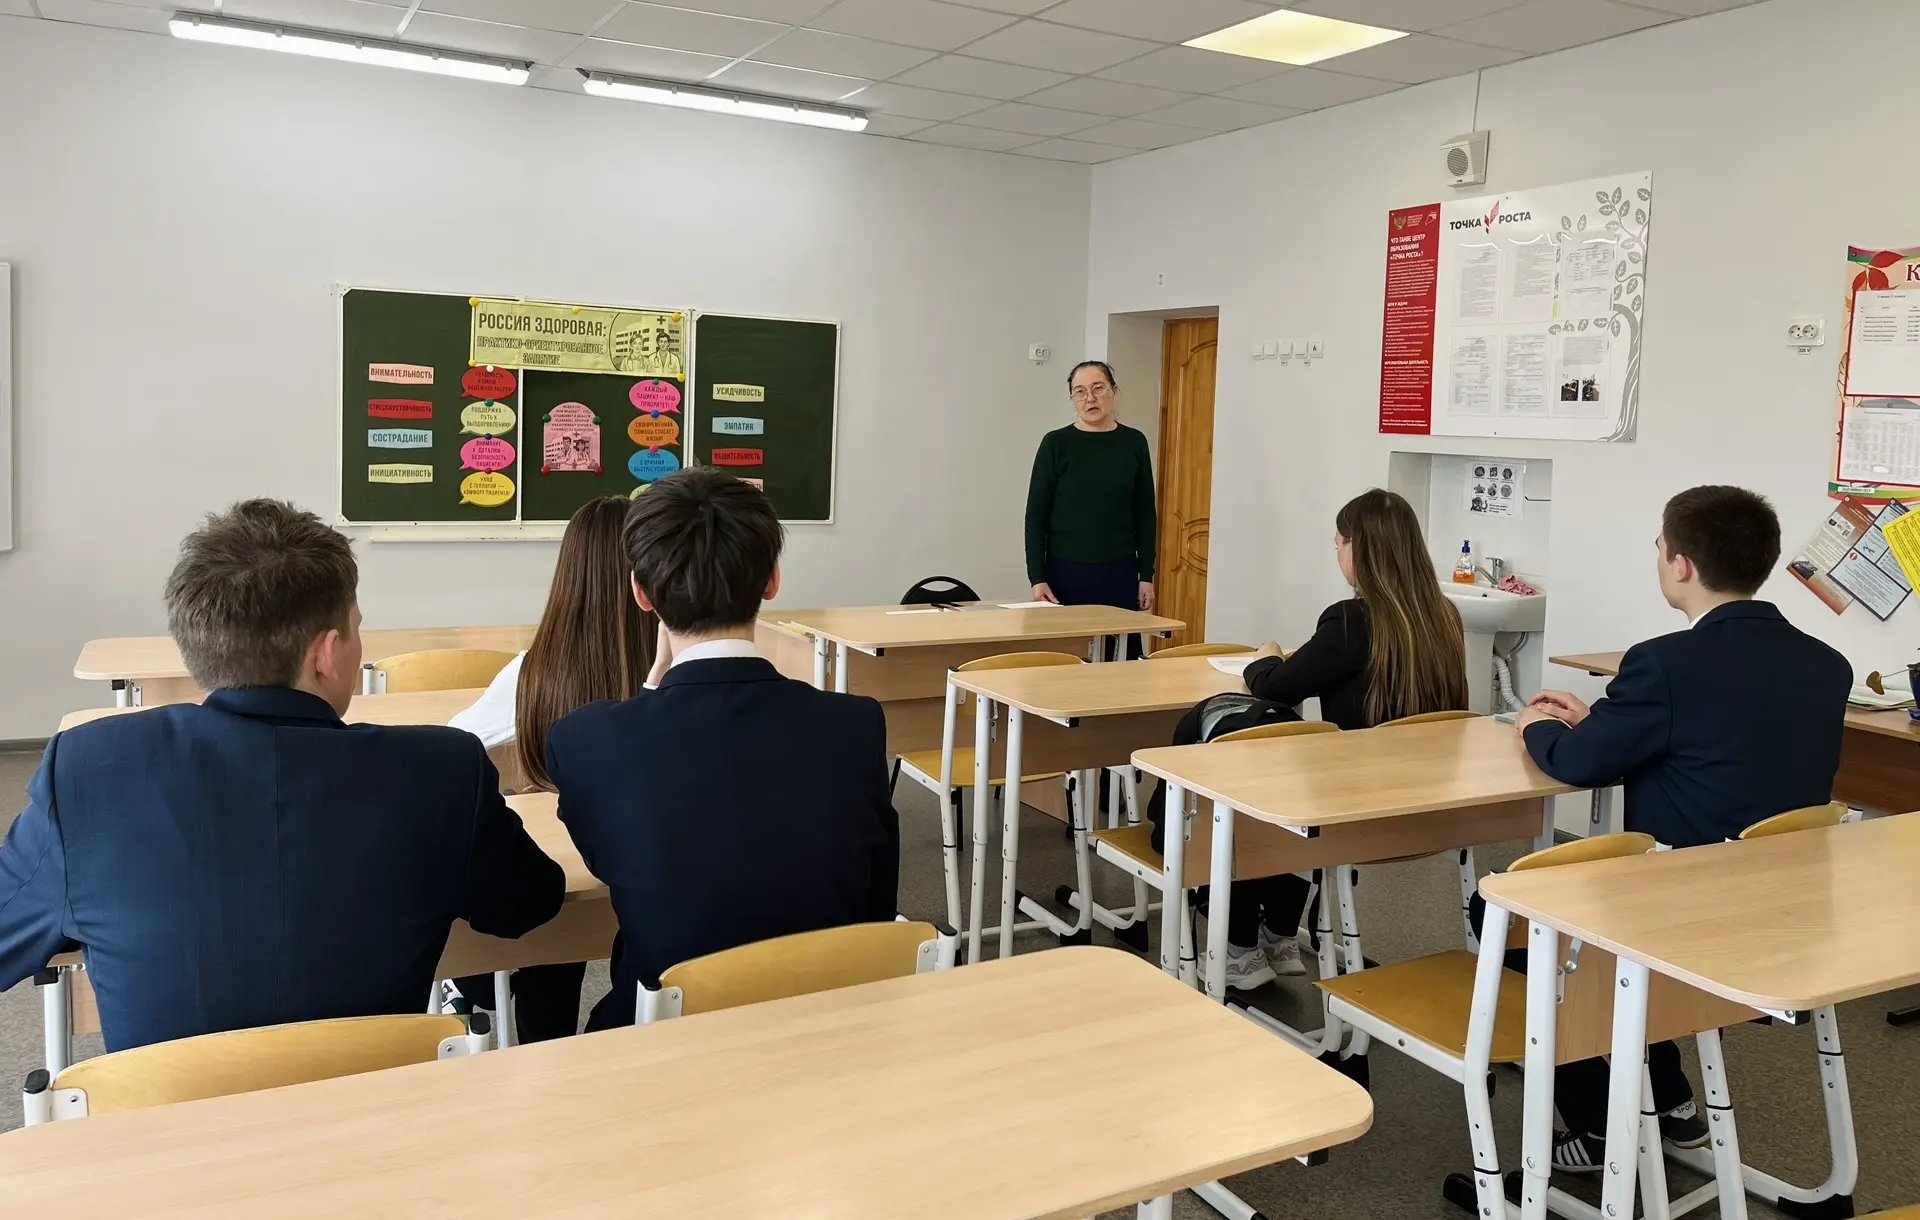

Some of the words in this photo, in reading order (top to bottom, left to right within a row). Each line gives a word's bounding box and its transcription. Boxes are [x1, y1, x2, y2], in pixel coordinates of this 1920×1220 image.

[1450, 218, 1482, 230] ТОЧКА
[1498, 211, 1532, 224] РОСТА
[478, 312, 531, 332] РОССИЯ
[535, 316, 607, 337] ЗДОРОВАЯ:
[477, 336, 605, 354] ПРАКТИКО-ОРИЕНТИРОВАННОЕ
[522, 354, 560, 366] ЗАНЯТИЕ
[370, 367, 433, 379] ВНИМАТЕЛЬНОСТЬ
[716, 387, 762, 397] УСИДЧИВОСТЬ
[369, 403, 432, 413] СТРЕССОУСТОЙЧИВОСТЬ
[724, 422, 754, 431] ЭМПАТИЯ
[372, 433, 428, 444] СОСТРАДАНИЕ
[714, 452, 760, 460] ОБЩИТЕЛЬНОСТЬ
[370, 469, 432, 478] ИНИЦИАТИВНОСТЬ
